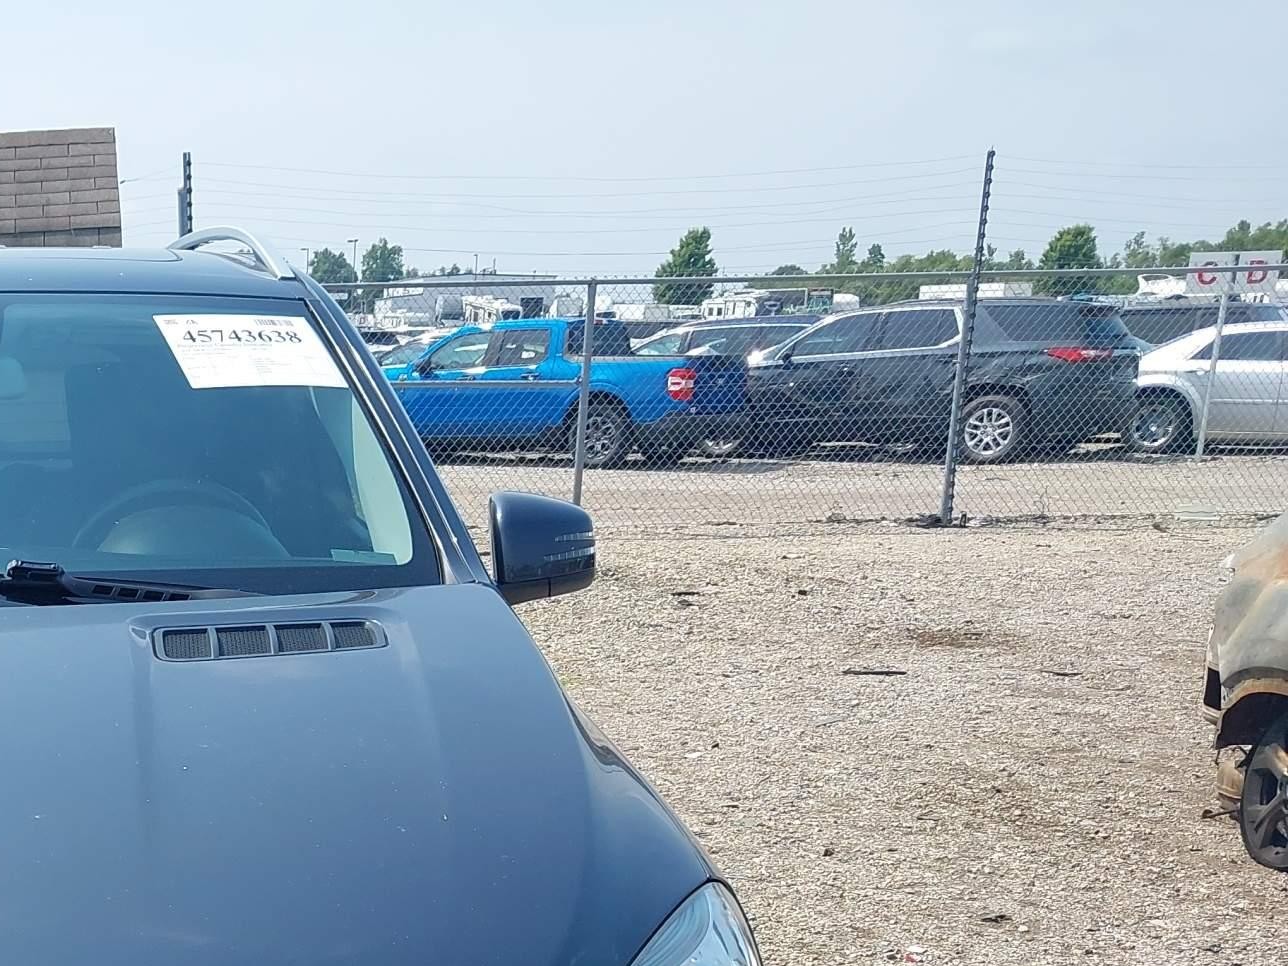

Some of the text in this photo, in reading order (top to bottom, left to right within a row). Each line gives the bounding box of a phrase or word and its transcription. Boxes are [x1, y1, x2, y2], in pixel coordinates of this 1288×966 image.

[1198, 260, 1268, 285] C D
[183, 329, 302, 343] 45743638
